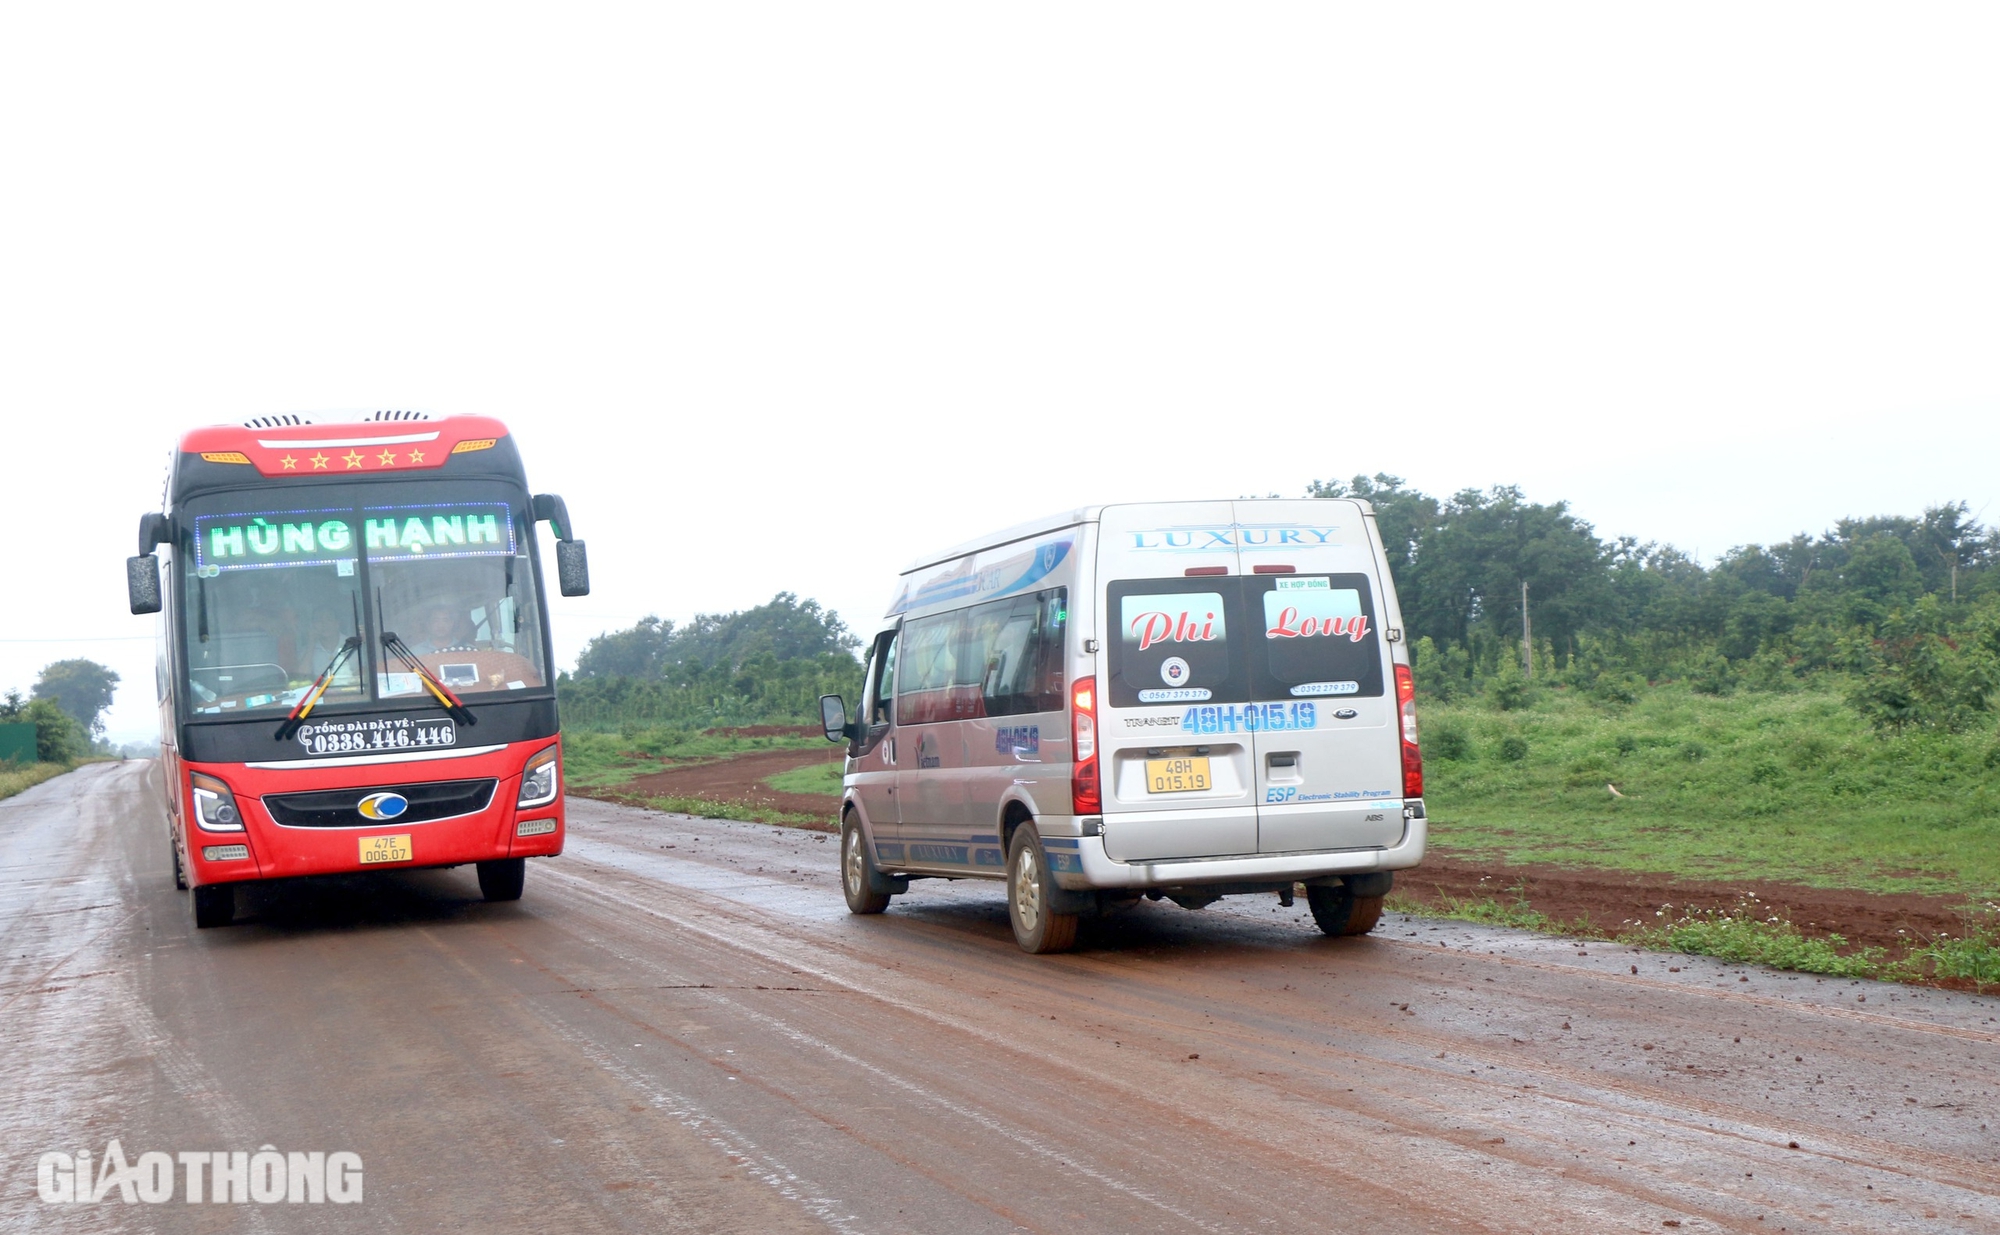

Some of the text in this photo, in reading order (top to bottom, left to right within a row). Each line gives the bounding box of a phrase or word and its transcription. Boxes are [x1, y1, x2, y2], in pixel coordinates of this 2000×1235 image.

[211, 514, 500, 558] HÙNG HẠNH
[1134, 529, 1336, 549] LUXURY
[1279, 581, 1289, 589] XE
[1131, 611, 1217, 651] Phi
[1265, 606, 1371, 642] Long
[1173, 690, 1190, 698] 379
[1191, 689, 1208, 698] 379
[1301, 682, 1357, 693] 0392 279 379
[314, 721, 344, 733] TỔNG
[347, 722, 367, 731] ĐÀI
[369, 719, 391, 731] ĐẶT
[1124, 716, 1179, 727] TRANSIT
[1182, 703, 1317, 734] 48H-015.19
[315, 726, 453, 752] 0338.446.446
[1166, 760, 1192, 774] 48H
[1155, 775, 1204, 790] 015.19
[1266, 787, 1296, 803] ESP
[1334, 791, 1360, 800] Stability
[1362, 789, 1391, 798] Program
[1365, 814, 1383, 822] ABS
[374, 838, 396, 849] 47E
[366, 849, 406, 862] 006.07
[918, 845, 959, 860] LUXURY
[1058, 853, 1070, 871] ESP
